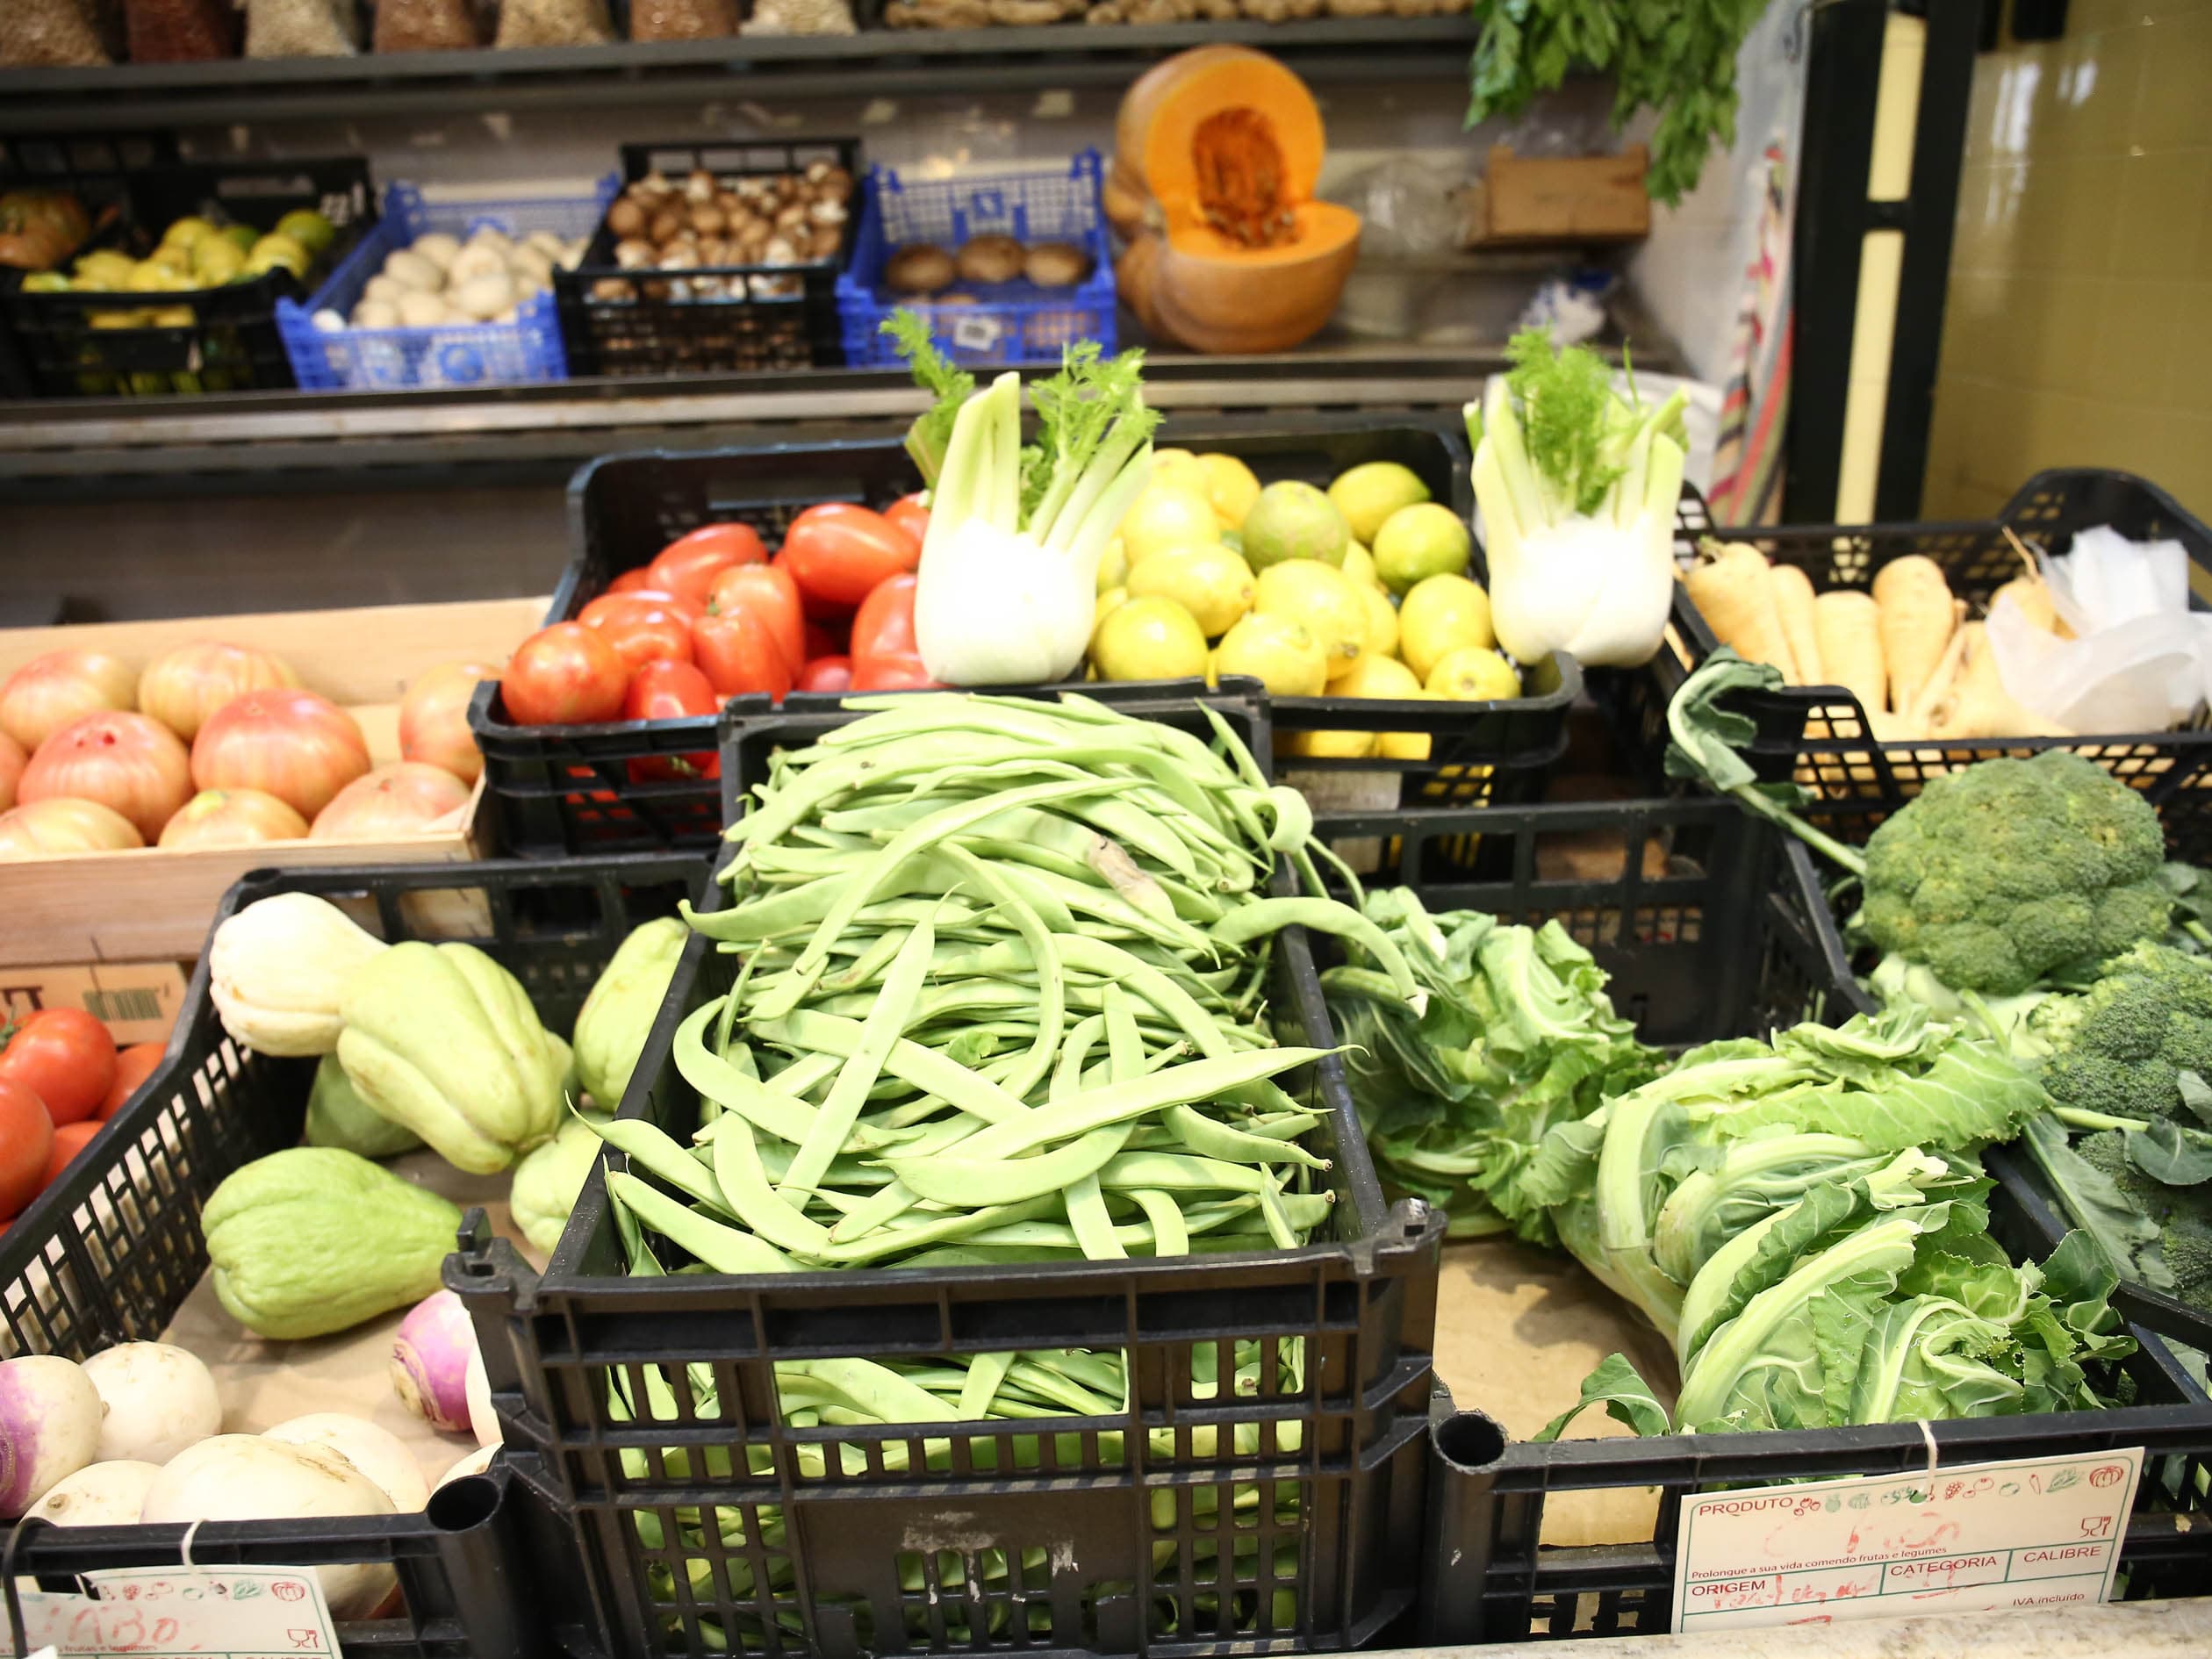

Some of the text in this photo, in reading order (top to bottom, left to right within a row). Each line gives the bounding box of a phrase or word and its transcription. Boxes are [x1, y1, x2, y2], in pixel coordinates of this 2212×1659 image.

[1699, 1497, 1793, 1516] PRODUTO
[1691, 1568, 1748, 1579] Prolongue
[1780, 1560, 1802, 1570] vida
[1805, 1555, 1856, 1569] comendo
[1859, 1553, 1889, 1564] frutas
[1900, 1547, 1947, 1560] legumes
[2023, 1545, 2102, 1563] CALIBRE
[1890, 1555, 1997, 1576] CATEGORIA
[1691, 1580, 1765, 1597] ORIGEM
[2013, 1598, 2034, 1606] IVA
